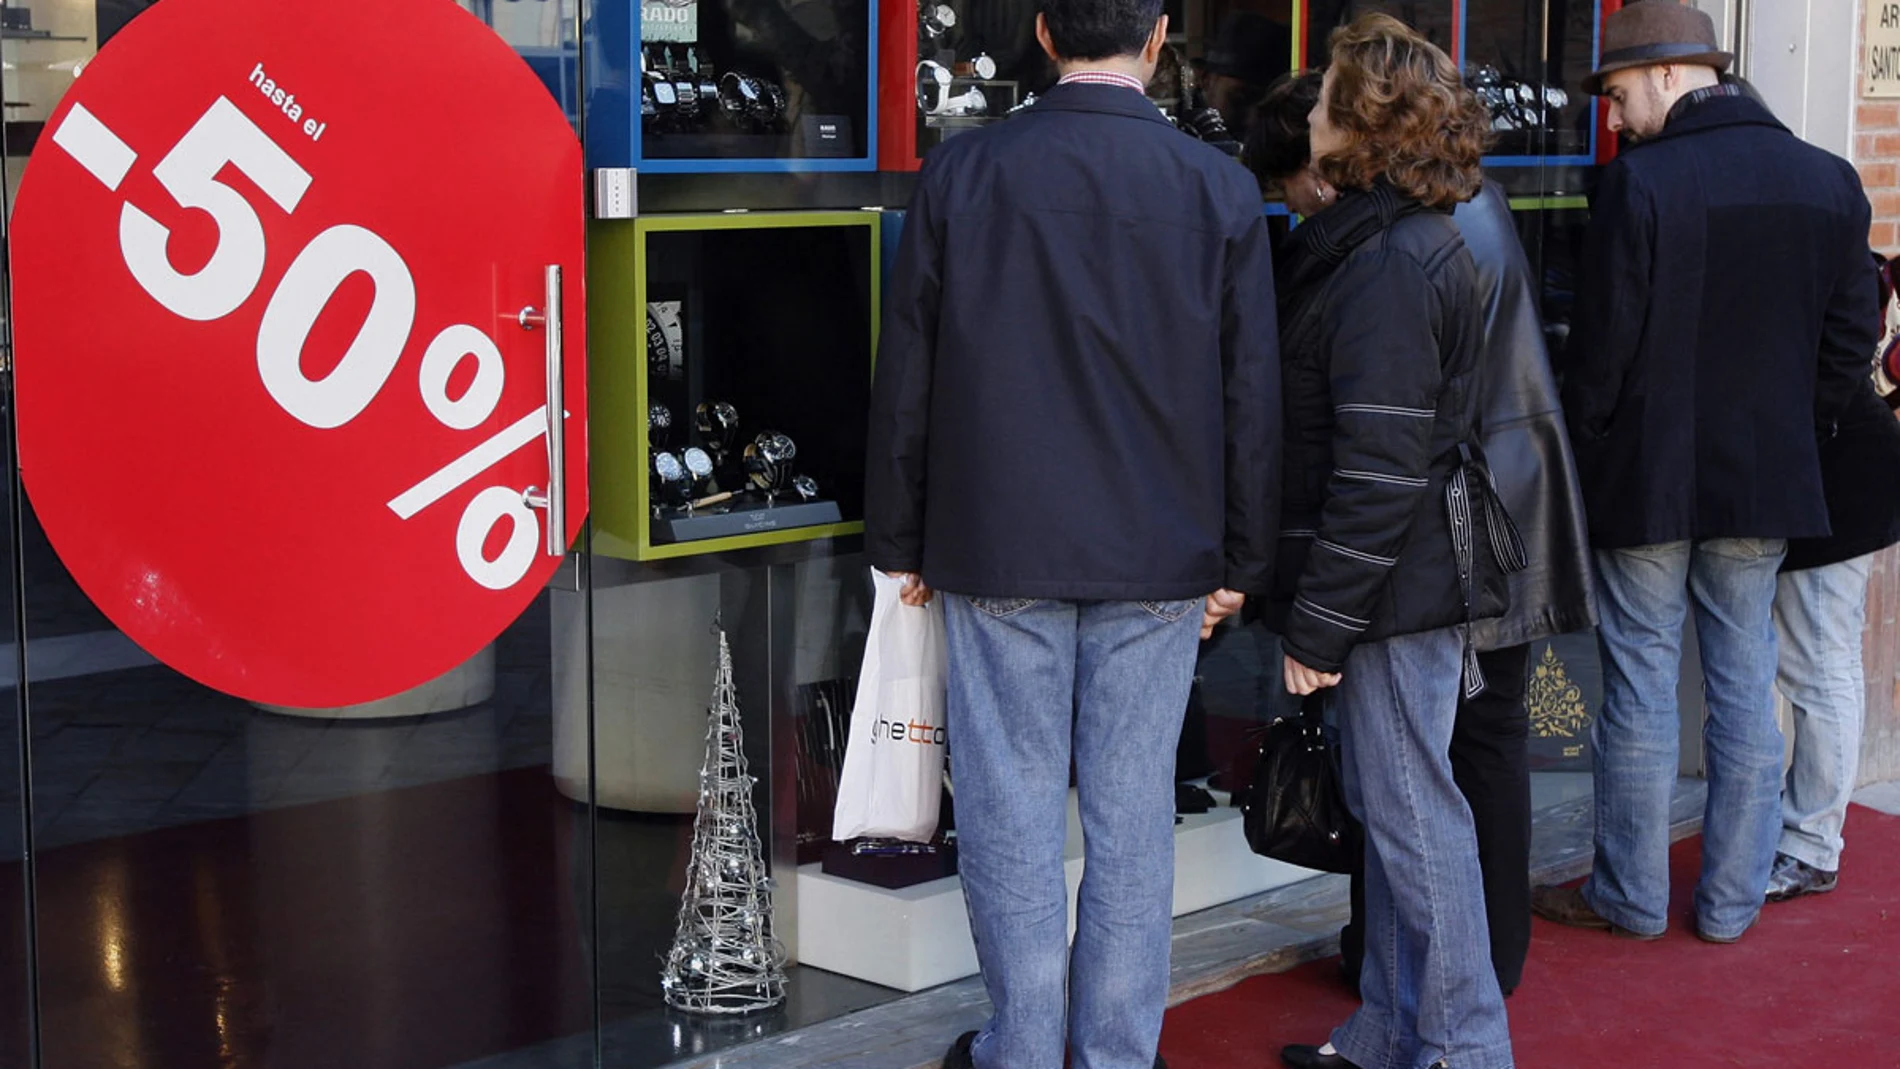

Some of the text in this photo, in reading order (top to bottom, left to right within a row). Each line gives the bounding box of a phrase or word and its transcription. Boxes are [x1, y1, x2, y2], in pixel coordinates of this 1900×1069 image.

[248, 62, 327, 141] hasta el
[53, 95, 571, 590] -50%
[871, 713, 946, 745] ghetto
